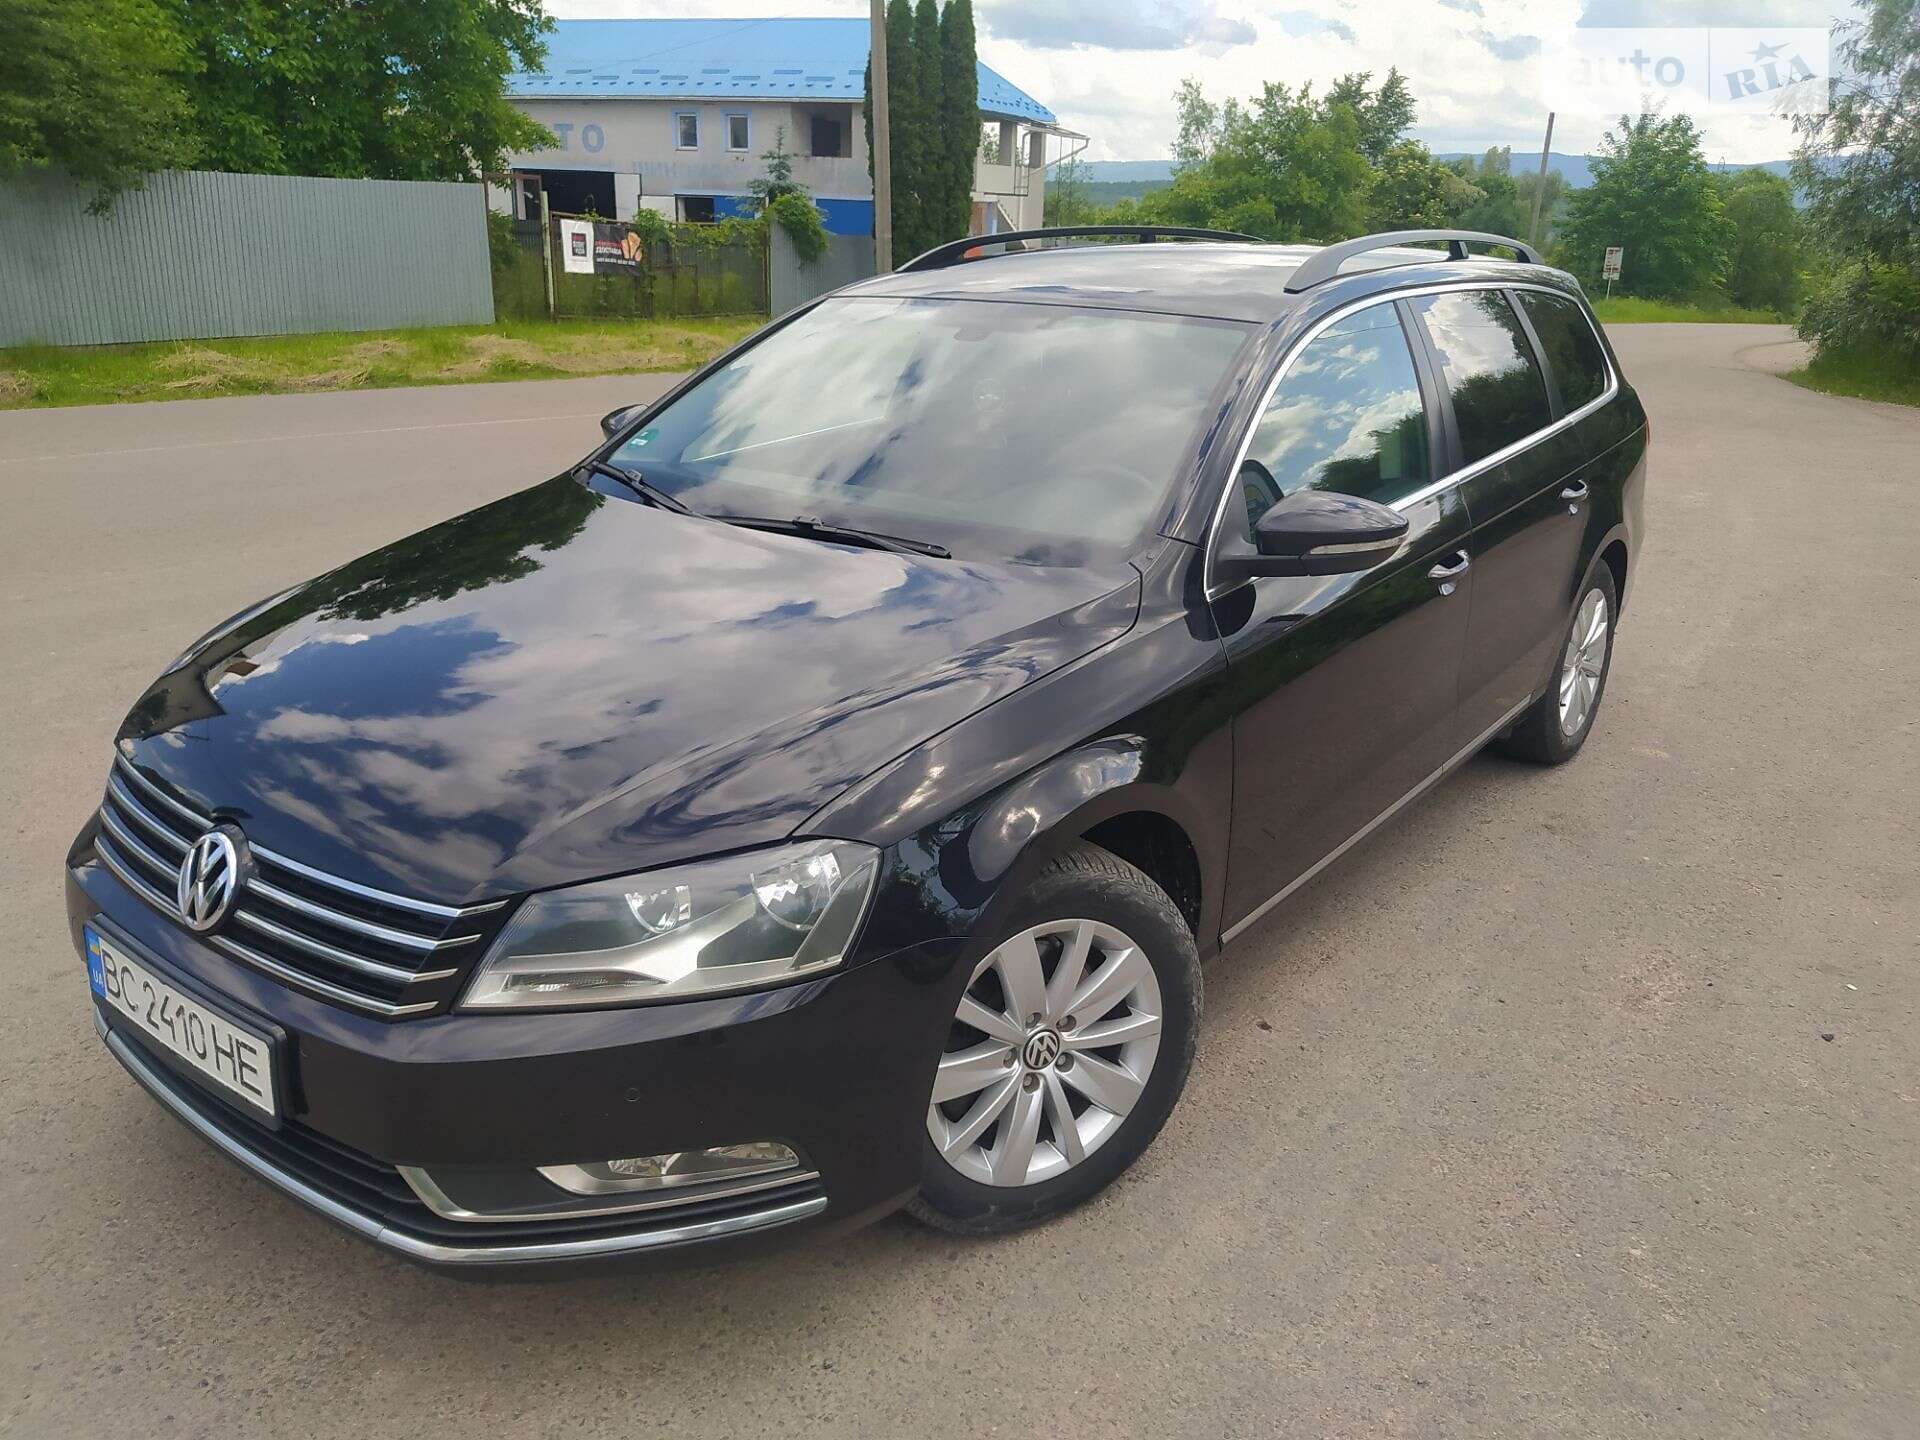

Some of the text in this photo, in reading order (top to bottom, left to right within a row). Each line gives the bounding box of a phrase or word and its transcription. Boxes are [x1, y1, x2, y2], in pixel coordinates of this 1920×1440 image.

[102, 951, 263, 1097] BC 2410 HE
